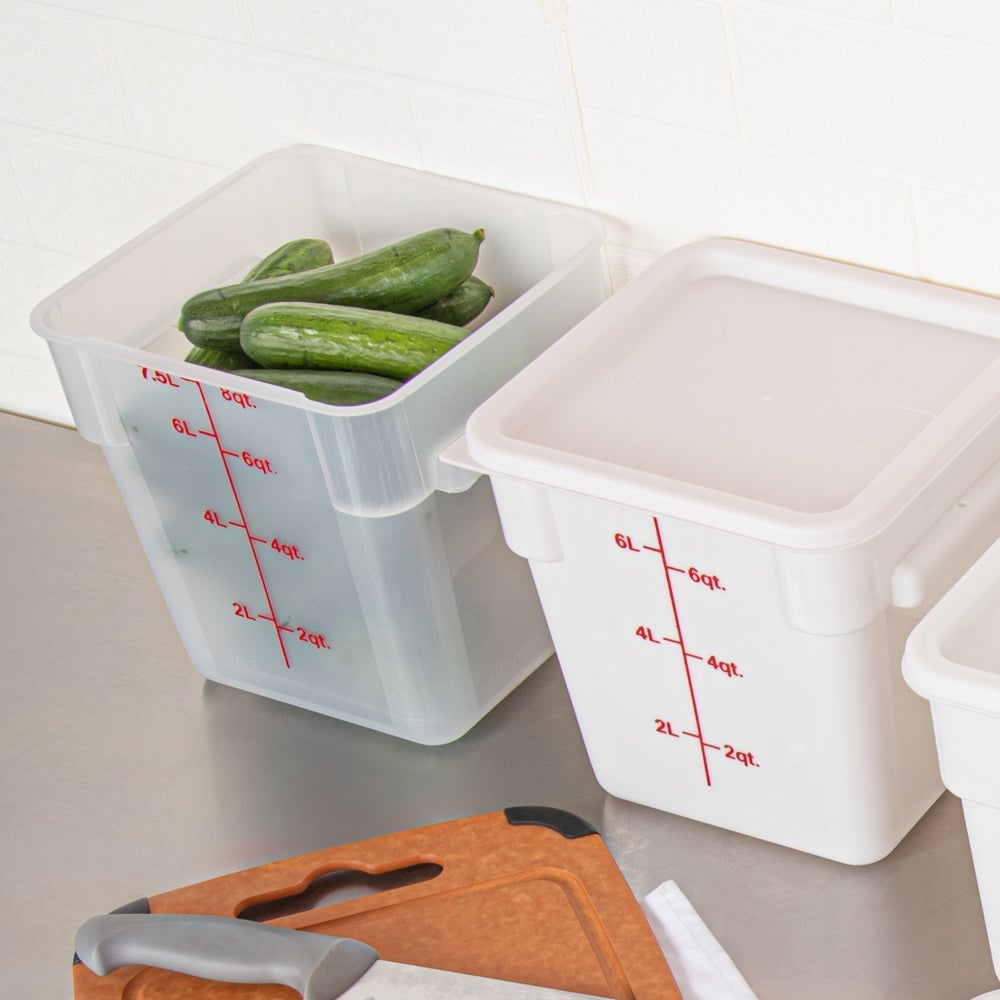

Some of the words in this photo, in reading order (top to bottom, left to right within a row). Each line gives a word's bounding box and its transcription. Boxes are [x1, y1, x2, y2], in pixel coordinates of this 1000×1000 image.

[171, 417, 197, 438] 6L
[241, 451, 278, 474] 6qt.
[203, 509, 228, 529] 4L
[270, 537, 305, 561] 4qt.
[613, 533, 641, 553] 6L
[688, 566, 727, 591] 6qt.
[231, 602, 257, 622] 2L
[295, 626, 332, 650] 2qt.
[635, 625, 661, 644] 4L
[706, 655, 744, 678] 4qt.
[654, 718, 680, 738] 2L
[723, 744, 761, 768] 2qt.
